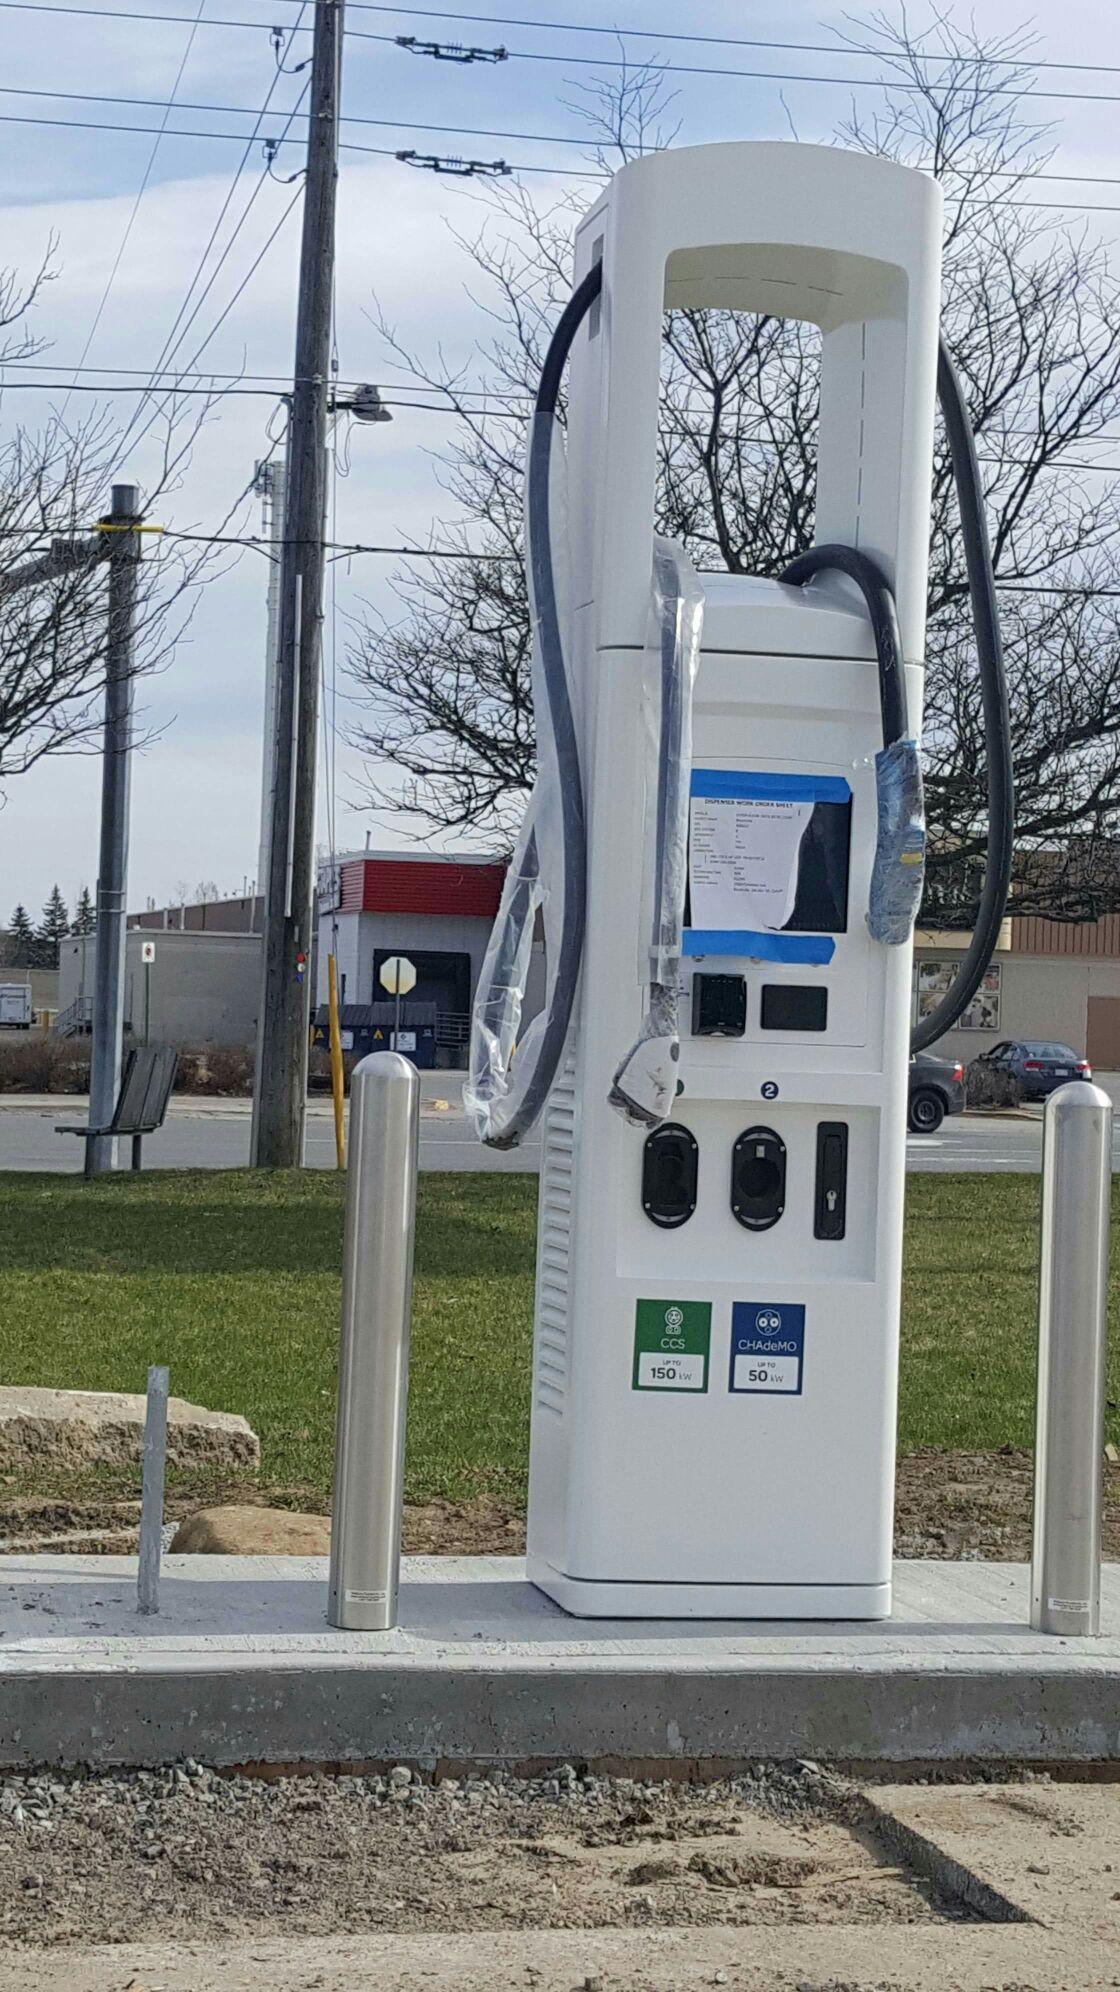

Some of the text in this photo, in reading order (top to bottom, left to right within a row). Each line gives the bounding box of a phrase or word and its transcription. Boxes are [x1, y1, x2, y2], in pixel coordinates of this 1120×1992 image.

[764, 1083, 777, 1097] 2
[660, 1338, 686, 1349] CCS
[738, 1339, 797, 1351] CHAdeMO
[651, 1367, 692, 1381] 150 kW
[748, 1370, 768, 1382] 50
